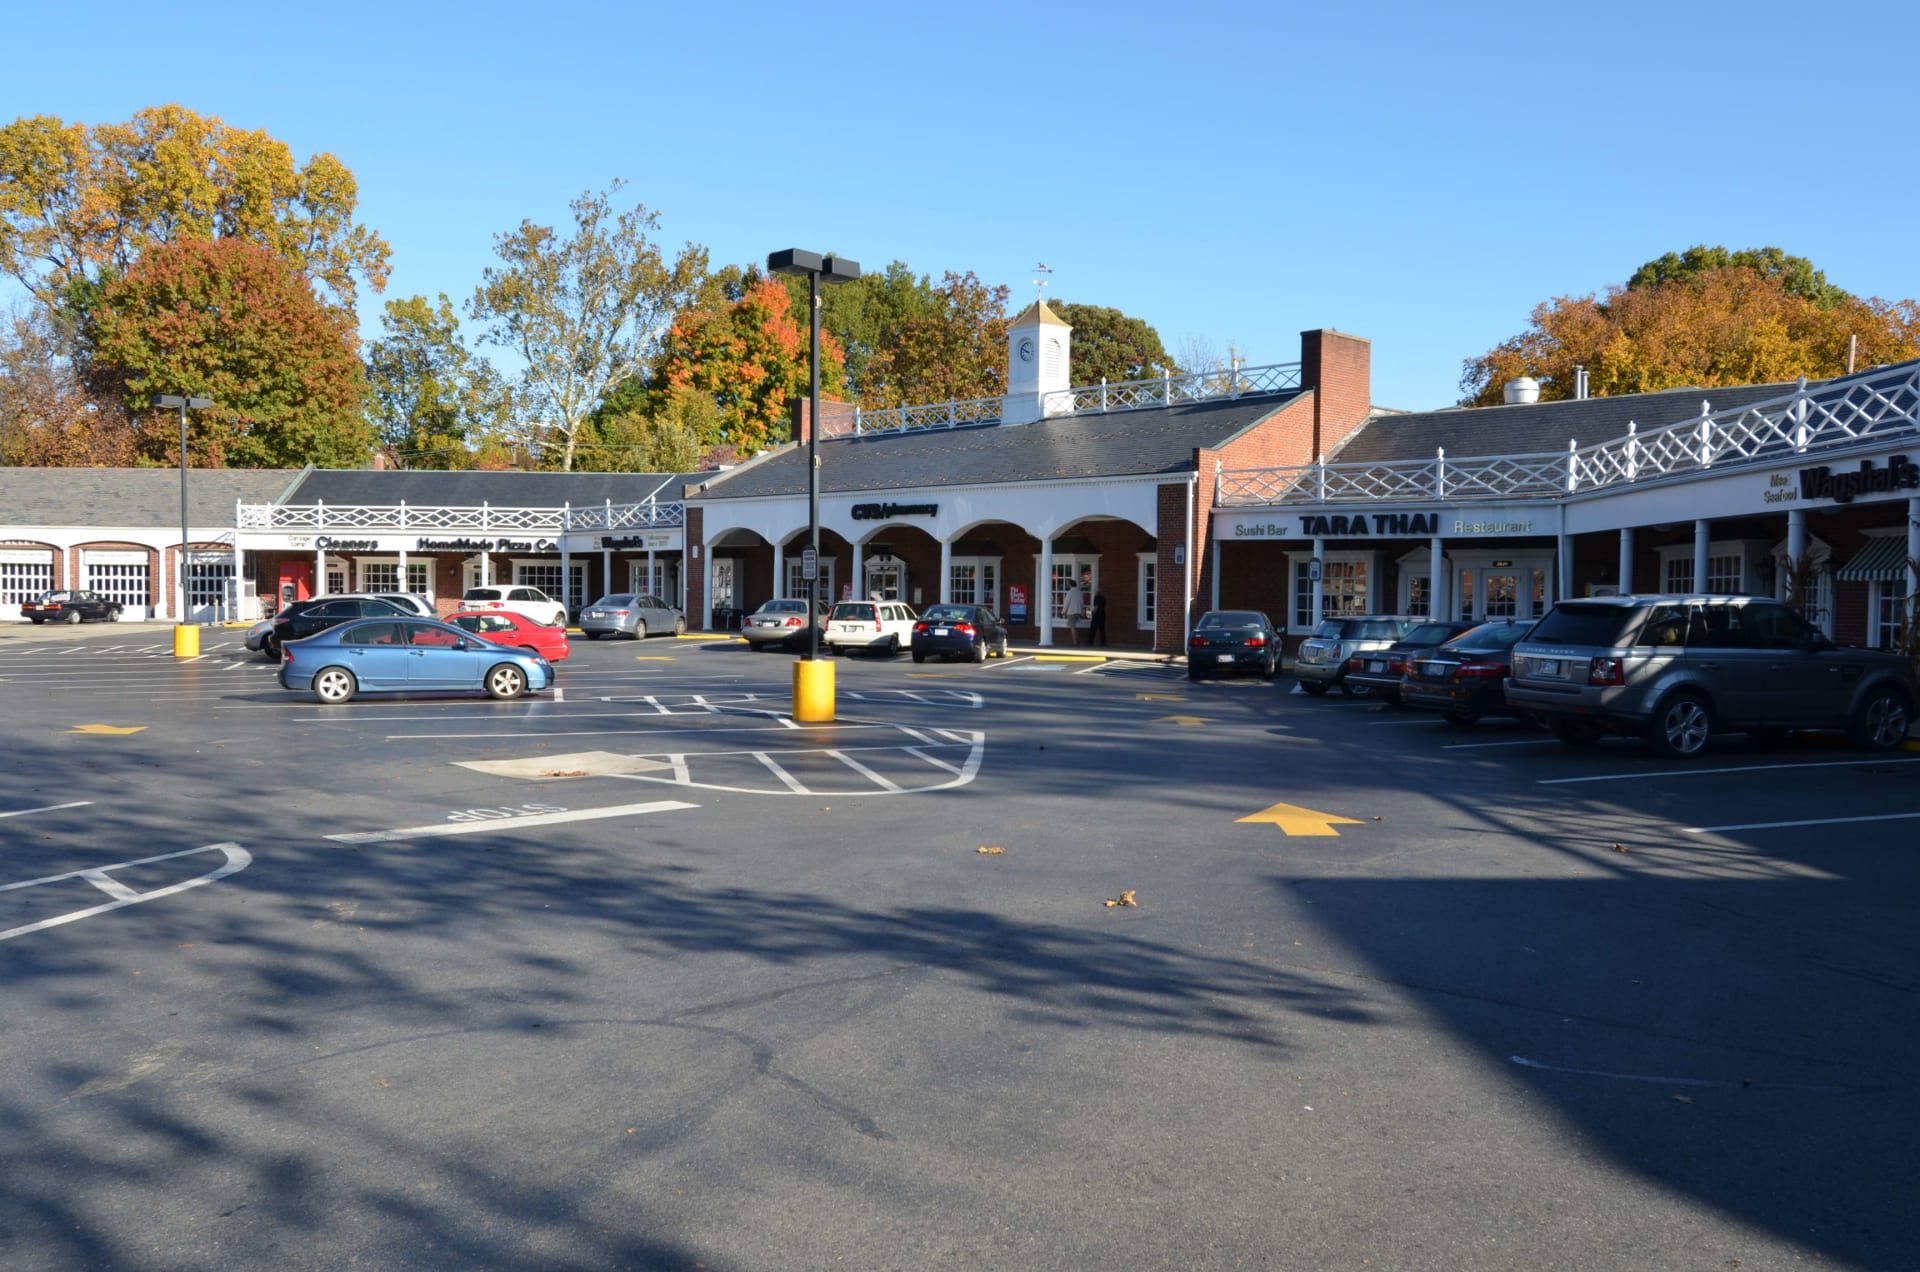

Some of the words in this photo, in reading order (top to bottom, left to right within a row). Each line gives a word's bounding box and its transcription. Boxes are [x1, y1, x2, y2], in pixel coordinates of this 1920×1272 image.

[1235, 524, 1265, 536] Sushi
[1267, 524, 1288, 536] Bar
[1299, 514, 1369, 535] TARA
[1372, 513, 1438, 534] THAI
[1454, 520, 1533, 533] Restaurant
[315, 536, 378, 550] Cleaners
[418, 538, 492, 551] HomeMade
[497, 539, 531, 551] Pizza
[534, 539, 557, 551] Co.
[447, 802, 568, 822] STOP
